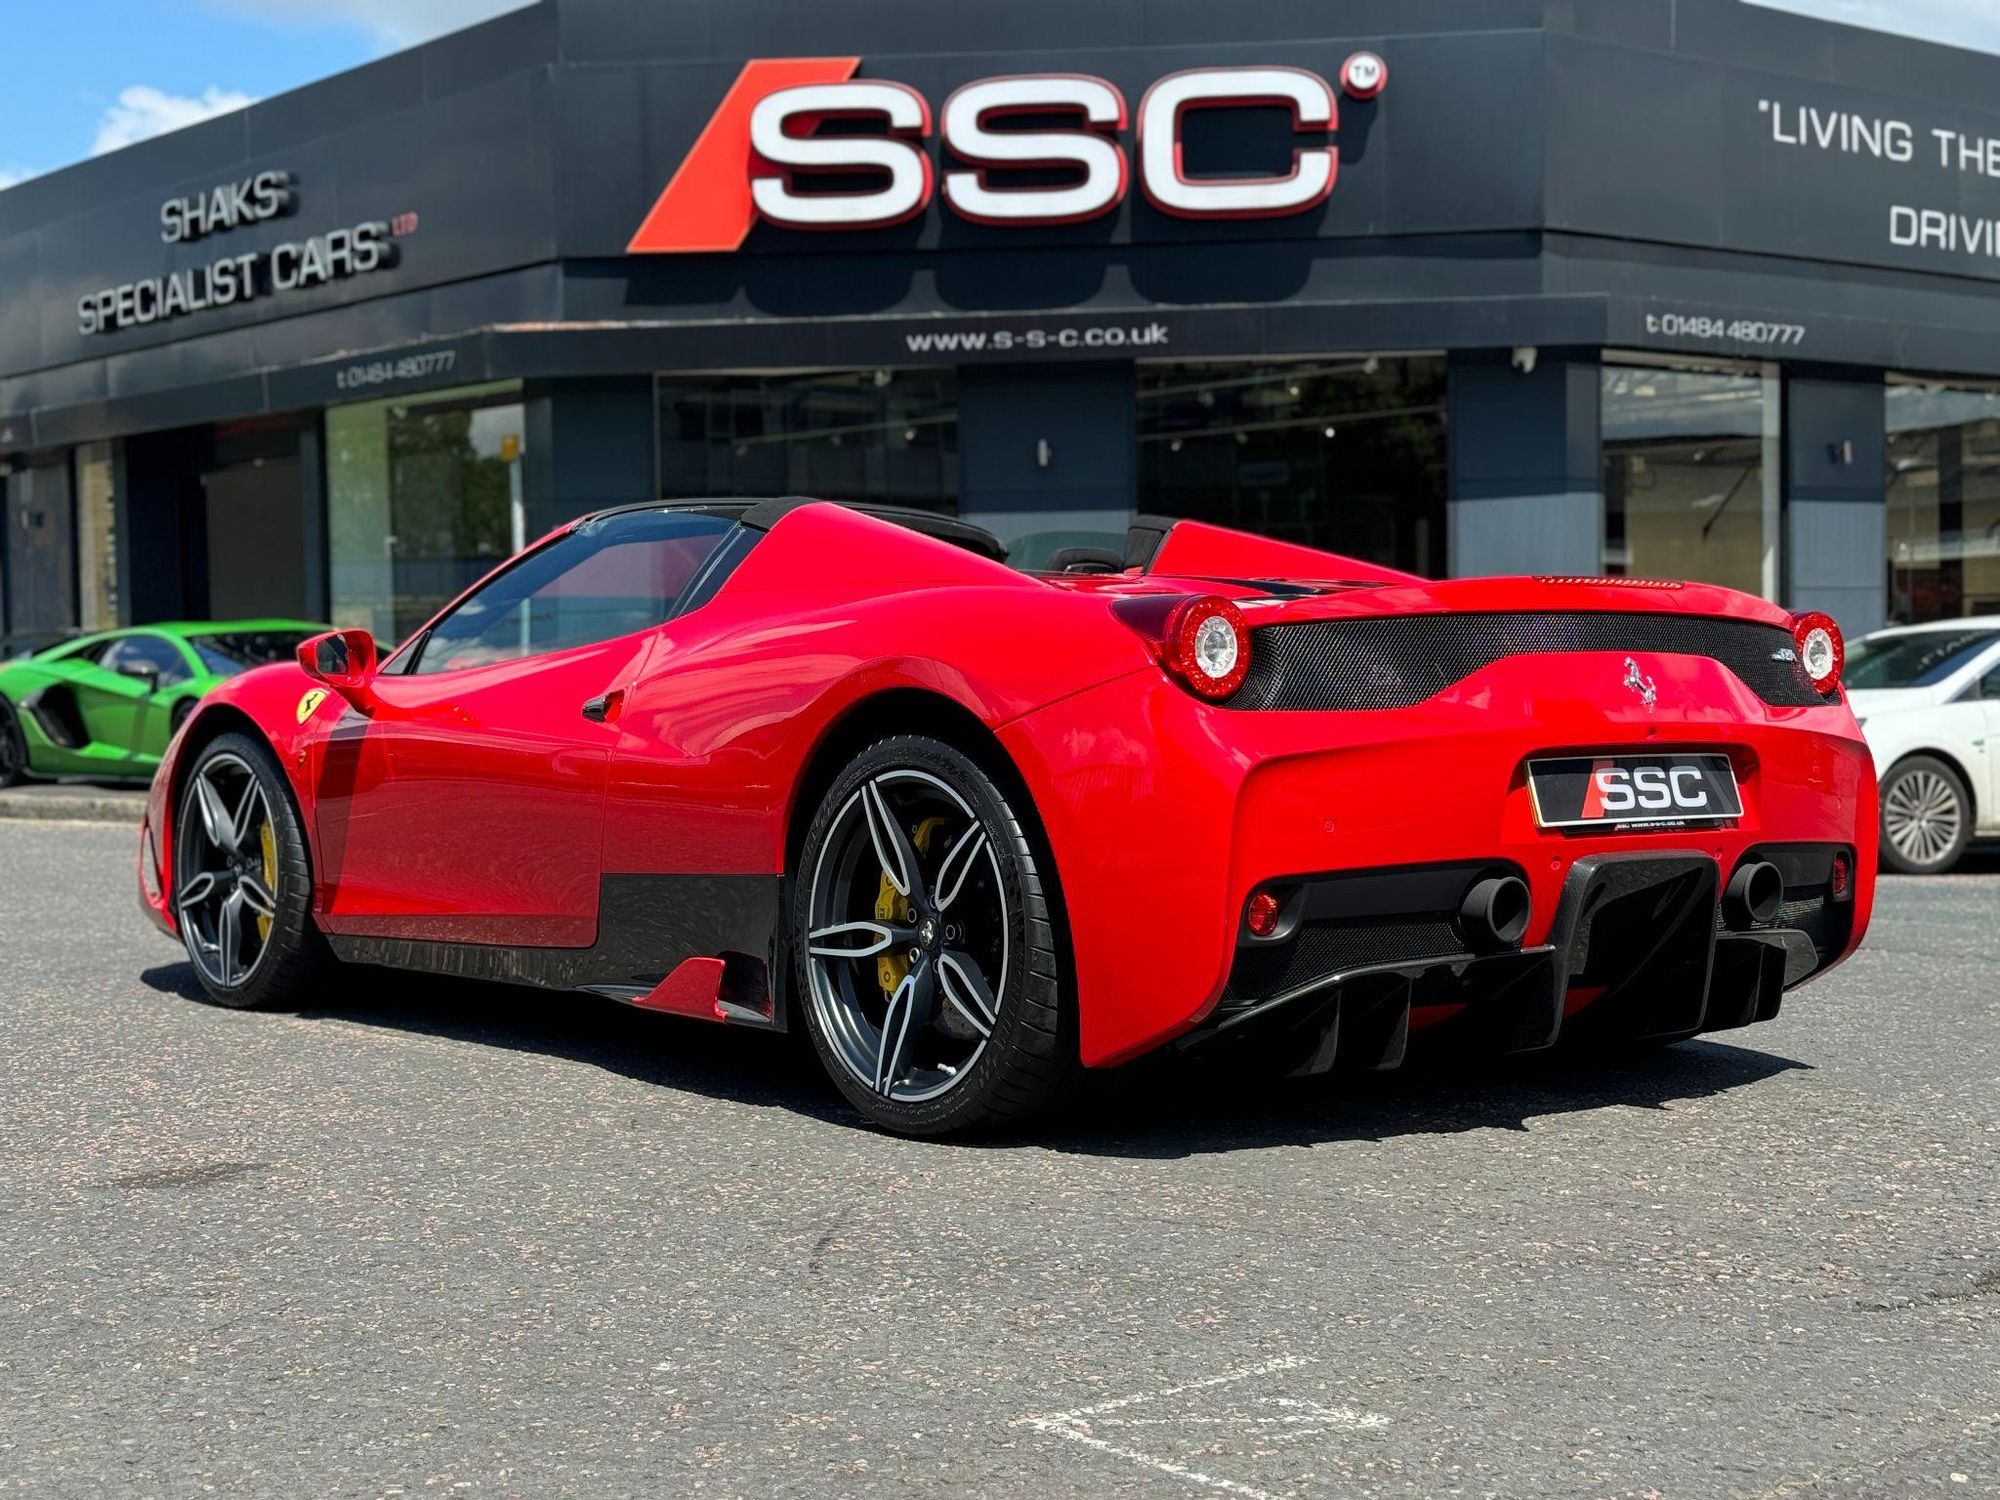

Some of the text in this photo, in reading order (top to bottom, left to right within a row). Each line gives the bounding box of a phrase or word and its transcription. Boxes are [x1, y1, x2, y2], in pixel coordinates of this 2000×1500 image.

[1354, 65, 1376, 78] TM
[748, 66, 1340, 232] SSC
[1931, 128, 2000, 177] THE
[160, 170, 289, 243] SHAKS
[1889, 205, 2000, 258] DRIVI
[77, 252, 258, 335] SPECIALIST
[271, 221, 390, 290] CARS
[905, 322, 1169, 352] www.s-s-c.co.uk
[1727, 321, 1805, 345] 480777
[1595, 766, 1707, 811] SSC
